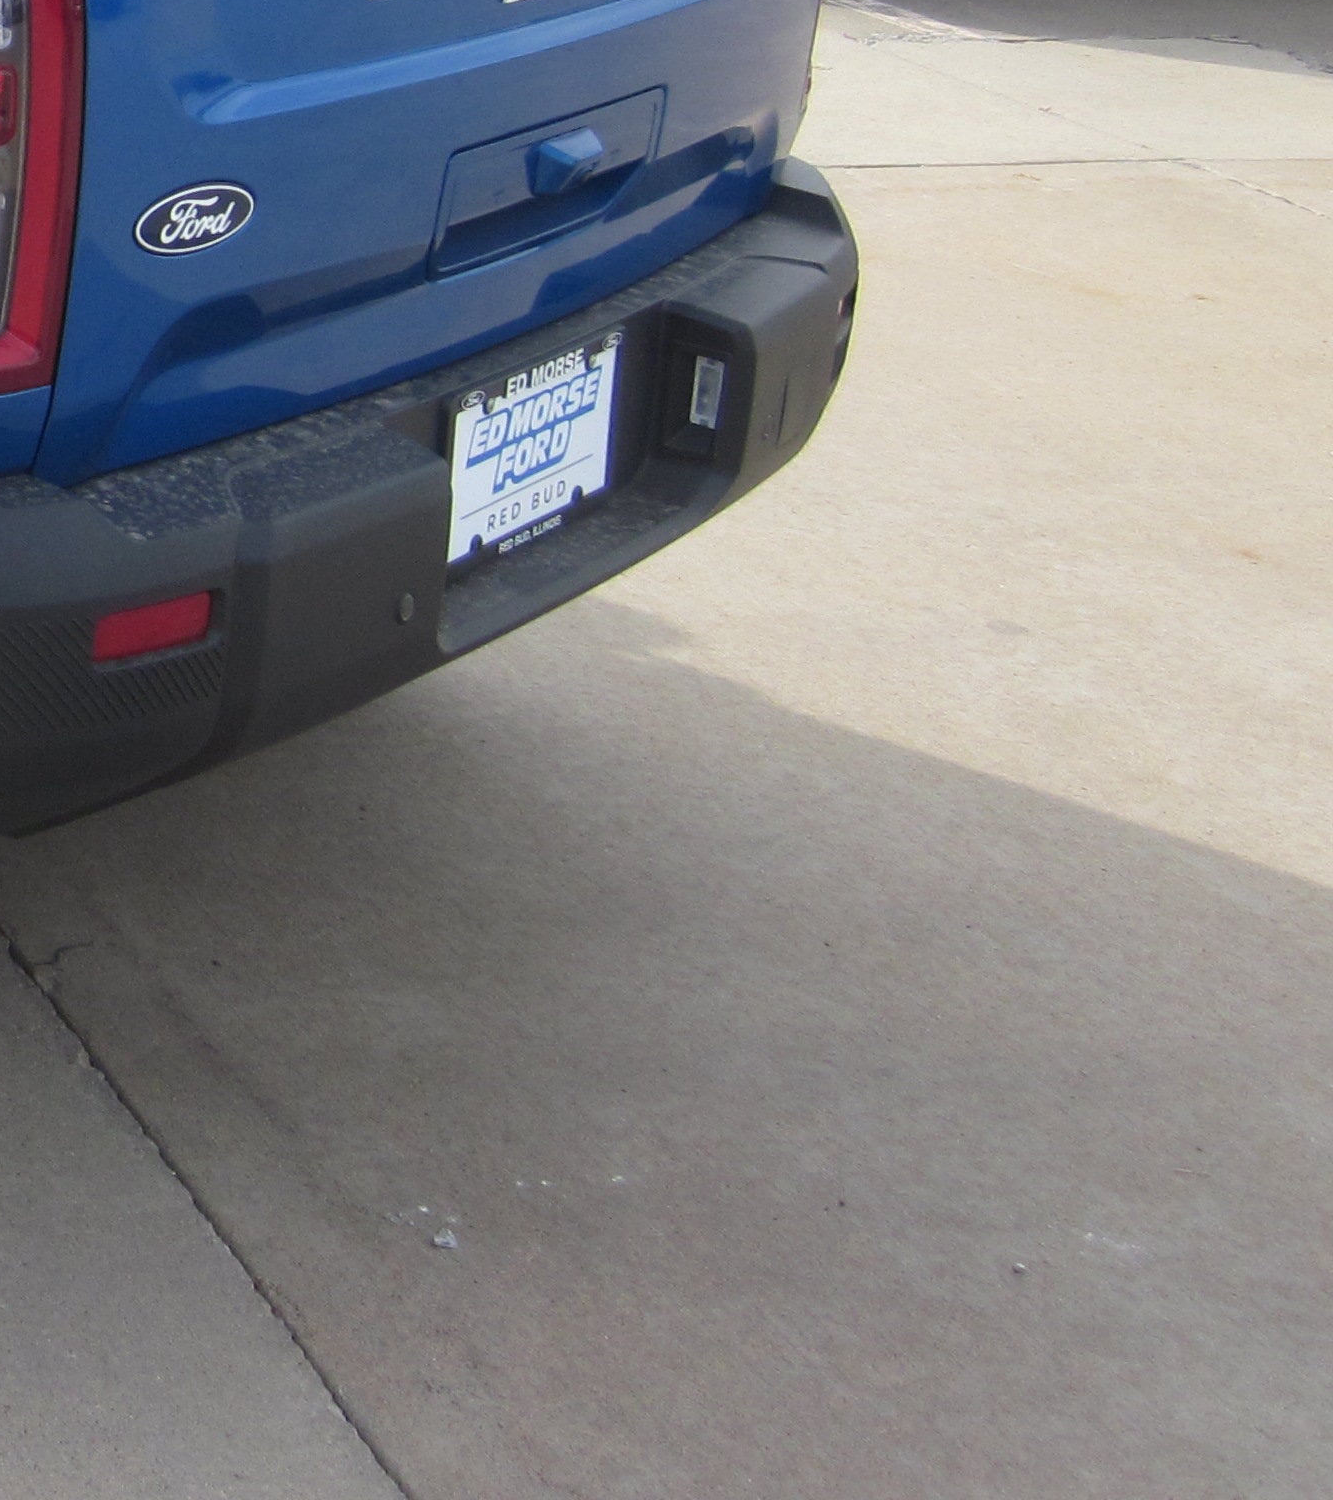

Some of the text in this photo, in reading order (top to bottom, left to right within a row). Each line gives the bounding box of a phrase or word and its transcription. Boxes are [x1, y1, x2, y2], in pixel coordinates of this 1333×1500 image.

[160, 195, 236, 245] Ford
[507, 347, 584, 396] ED MORSE
[467, 366, 602, 462] ED MORSE
[494, 420, 572, 491] FORD
[487, 480, 566, 532] RED BUD
